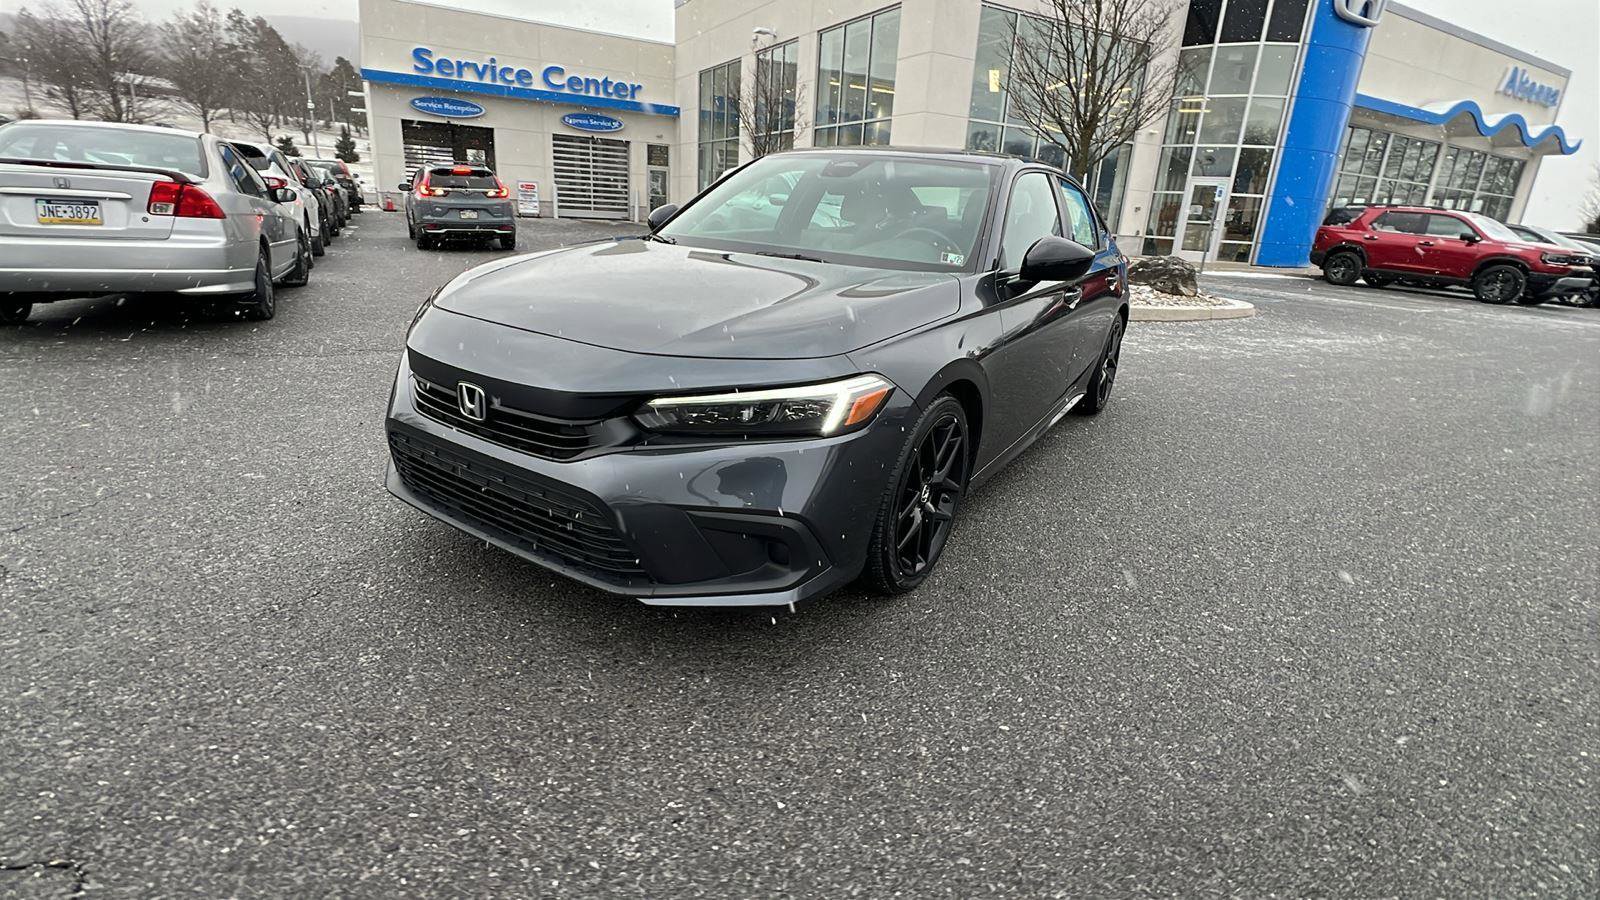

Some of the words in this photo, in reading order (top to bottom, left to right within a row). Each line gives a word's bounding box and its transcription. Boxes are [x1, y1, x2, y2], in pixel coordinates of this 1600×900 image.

[411, 47, 533, 86] Service
[542, 65, 643, 99] Center
[414, 100, 443, 109] Service
[443, 102, 481, 114] Reception
[589, 119, 612, 127] Service
